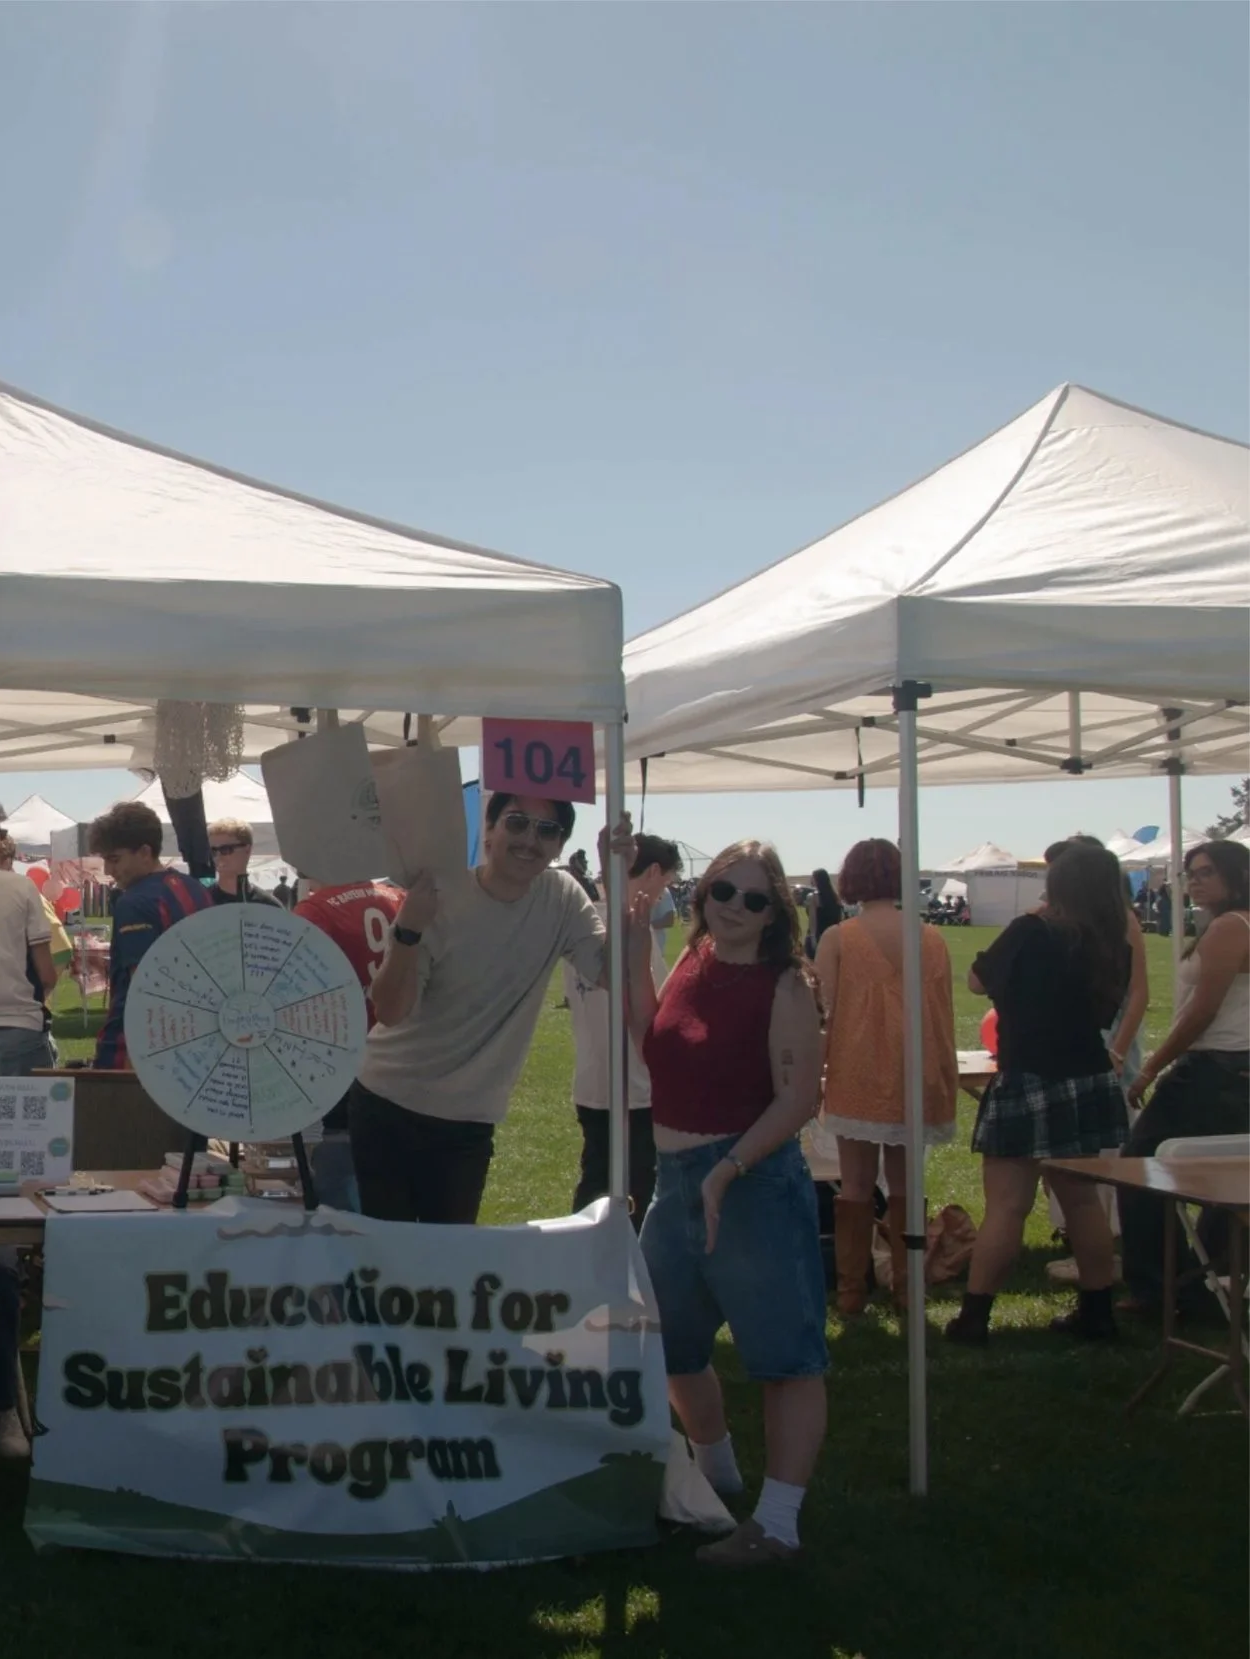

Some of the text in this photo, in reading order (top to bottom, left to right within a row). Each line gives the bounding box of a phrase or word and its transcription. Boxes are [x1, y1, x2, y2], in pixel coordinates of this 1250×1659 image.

[494, 736, 587, 789] 104
[363, 906, 392, 979] 9
[145, 1267, 571, 1333] Education for
[62, 1345, 643, 1427] Sustainable Living
[223, 1429, 501, 1500] Program
